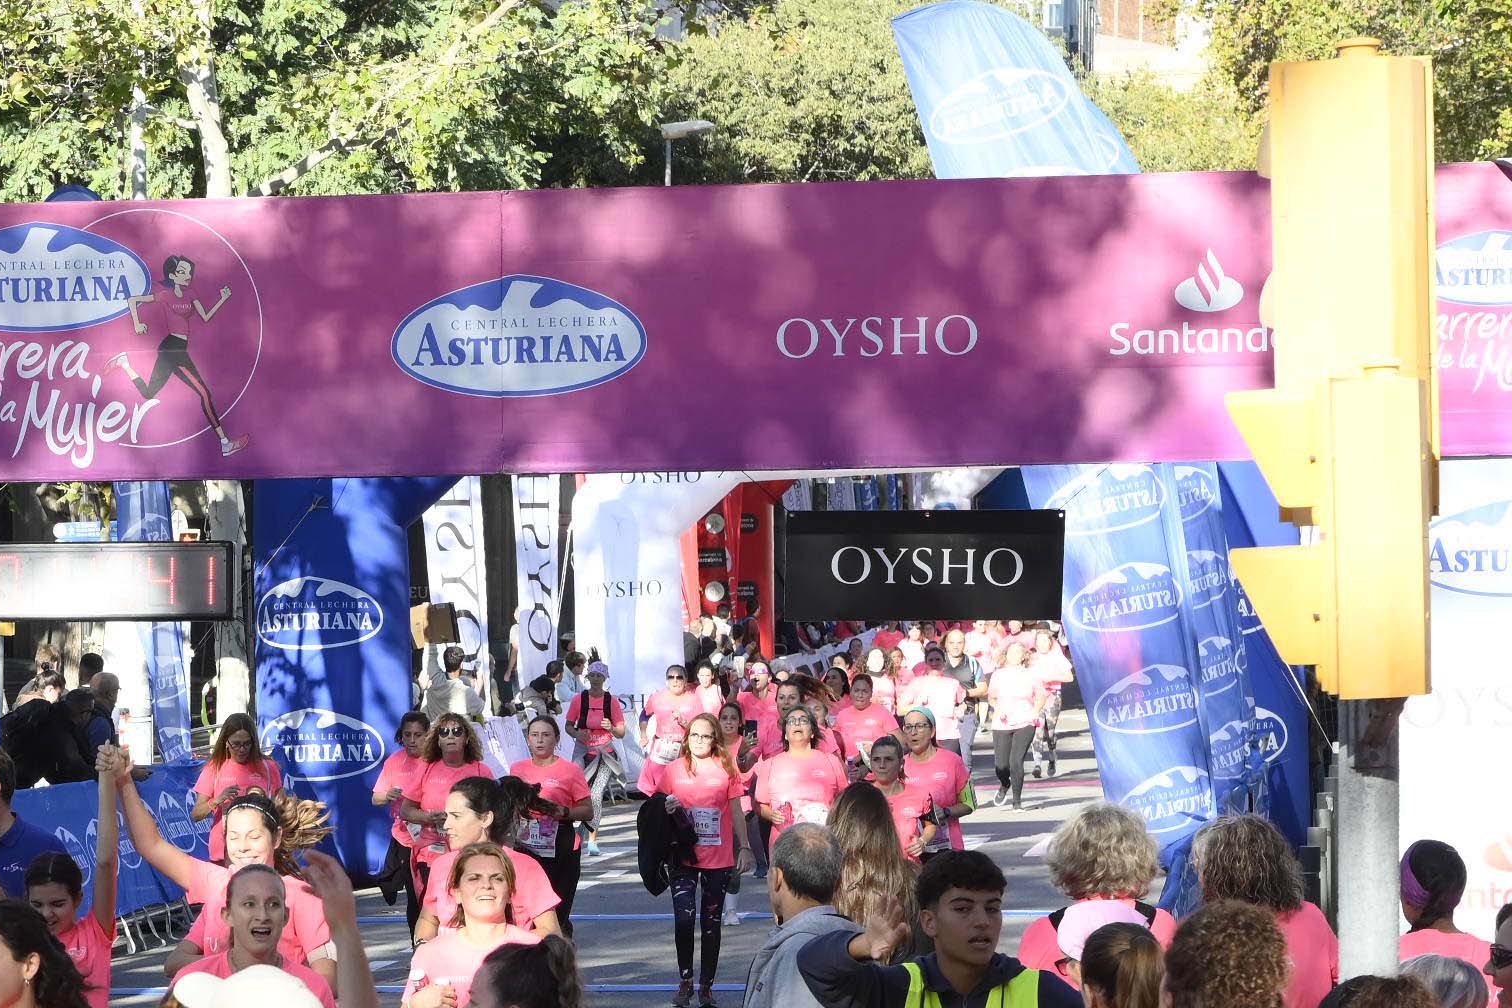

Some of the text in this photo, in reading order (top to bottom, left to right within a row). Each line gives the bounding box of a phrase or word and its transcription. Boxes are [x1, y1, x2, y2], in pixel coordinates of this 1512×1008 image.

[53, 258, 126, 271] LECHERA
[450, 315, 619, 331] CENTRAL LECHERA
[775, 314, 978, 359] OYSHO
[411, 323, 627, 367] ASTURIANA
[1109, 322, 1275, 356] Santand
[12, 375, 161, 469] Mujer
[831, 546, 1024, 587] OYSHO
[261, 606, 374, 634] ASTURIANA
[273, 601, 370, 611] CENTRAL LECHERA
[320, 732, 370, 742] LECHERA
